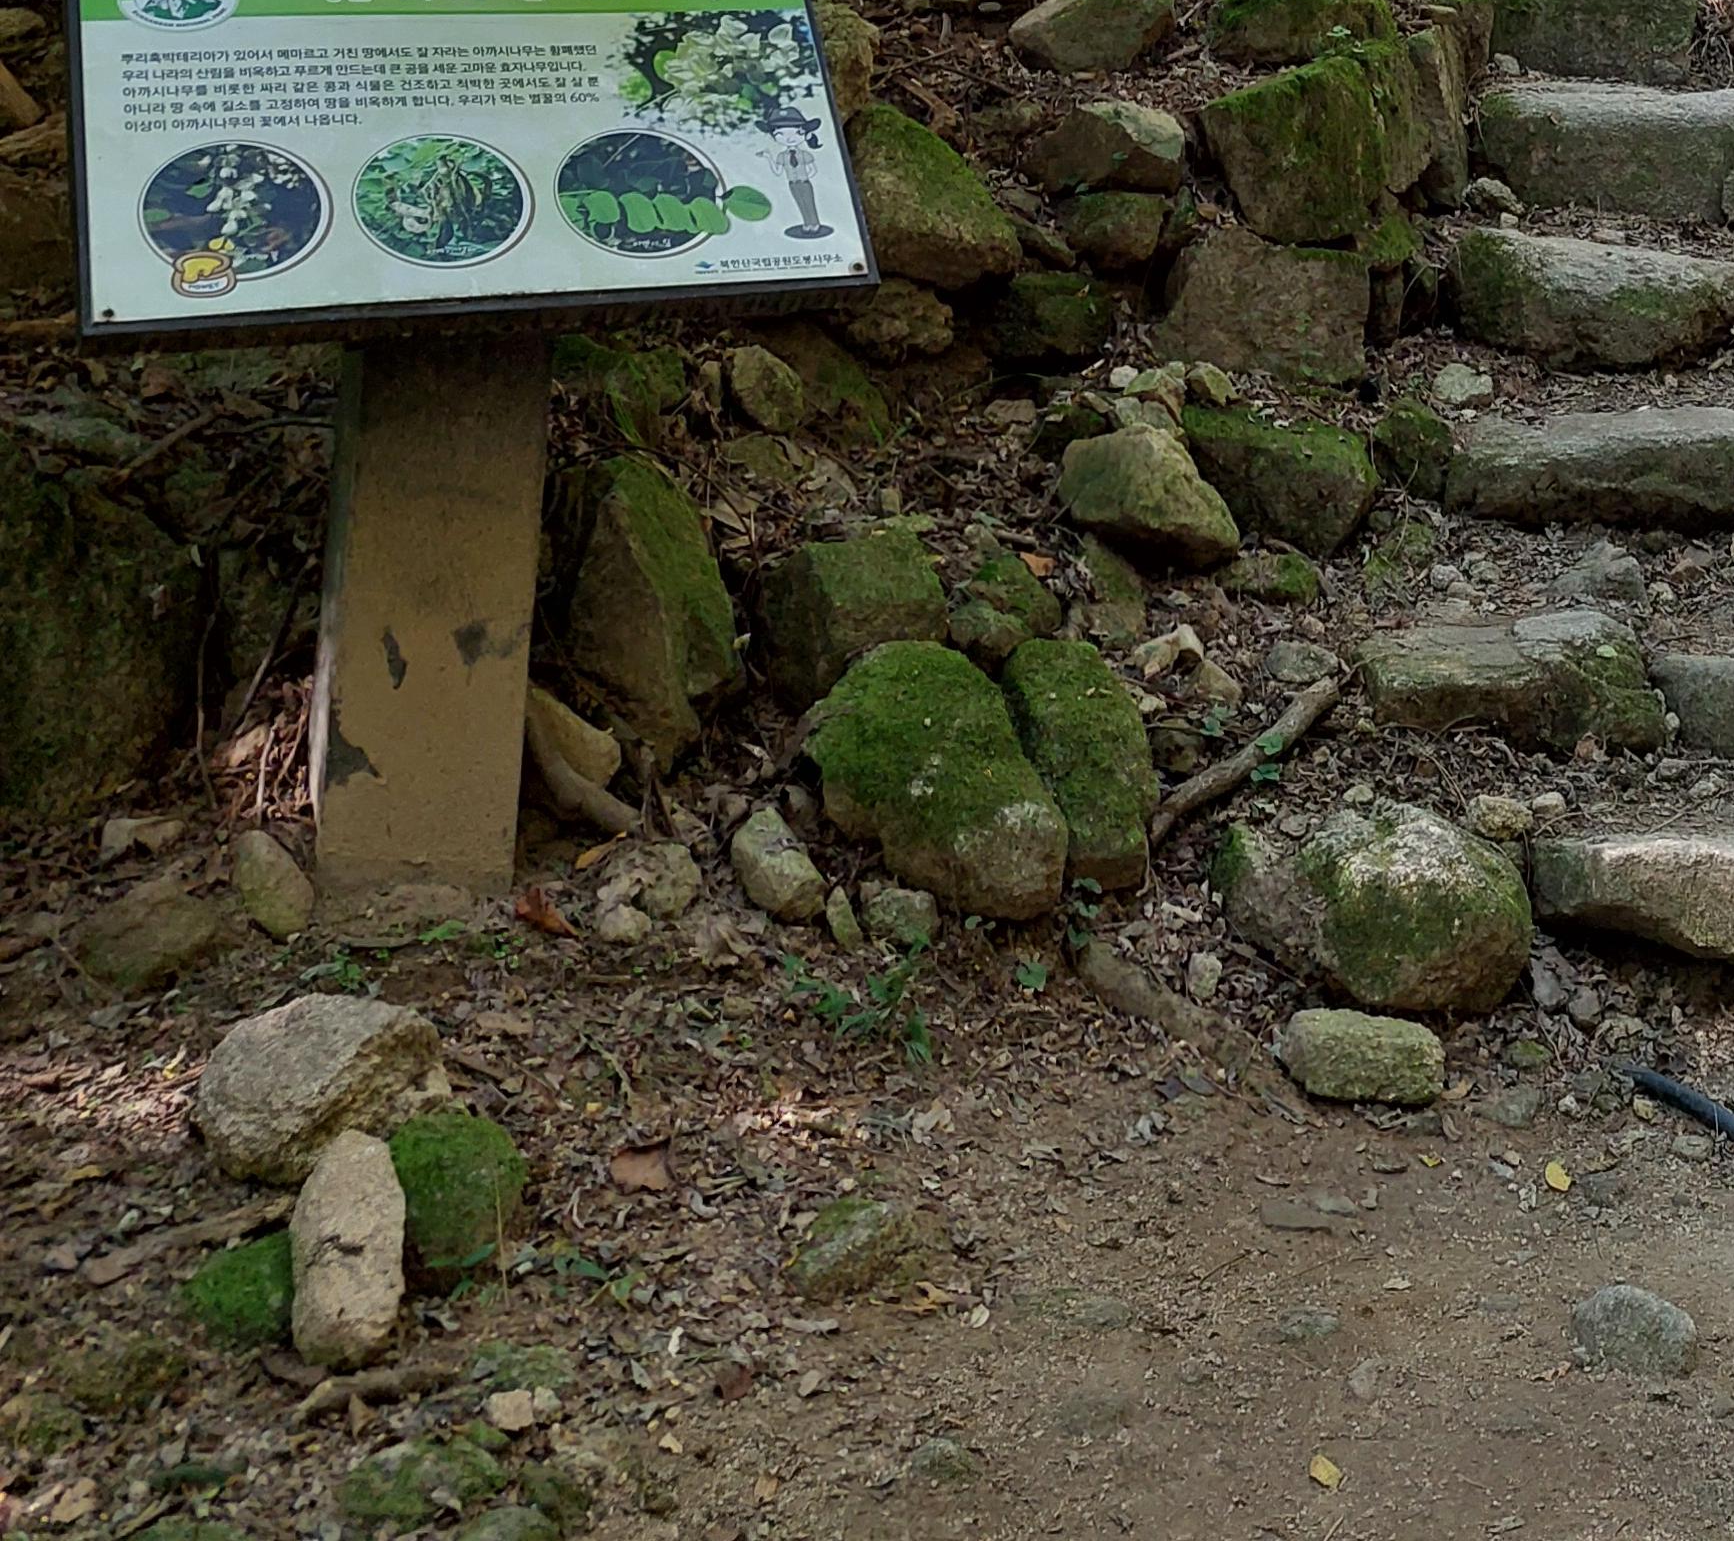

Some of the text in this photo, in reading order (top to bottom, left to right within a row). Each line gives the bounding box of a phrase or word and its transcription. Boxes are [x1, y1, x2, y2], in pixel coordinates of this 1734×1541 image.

[121, 44, 597, 64] 뿌리혹박테리아가 있어서 메마르고 거친 땅에서도 잘 자라는 아까시나무는 황폐했던
[122, 61, 586, 82] 우리 나라의 산림을 비옥하고 푸르게 만드는데 큰 공을 세운 고마운 효자나무입니다.
[123, 76, 599, 98] 아까시나무를 비롯한 싸리 같은 콩과 식물은 건조하고 척박한 곳에서도 잘 살 뿐
[124, 92, 600, 115] 아니라 땅 속에 질소를 고정하여 땅을 비옥하게 합니다. 우리가 먹는 벌꿀의 60%
[124, 114, 362, 132] 이상이 아까시나무의 꽃에서 나옵니다.
